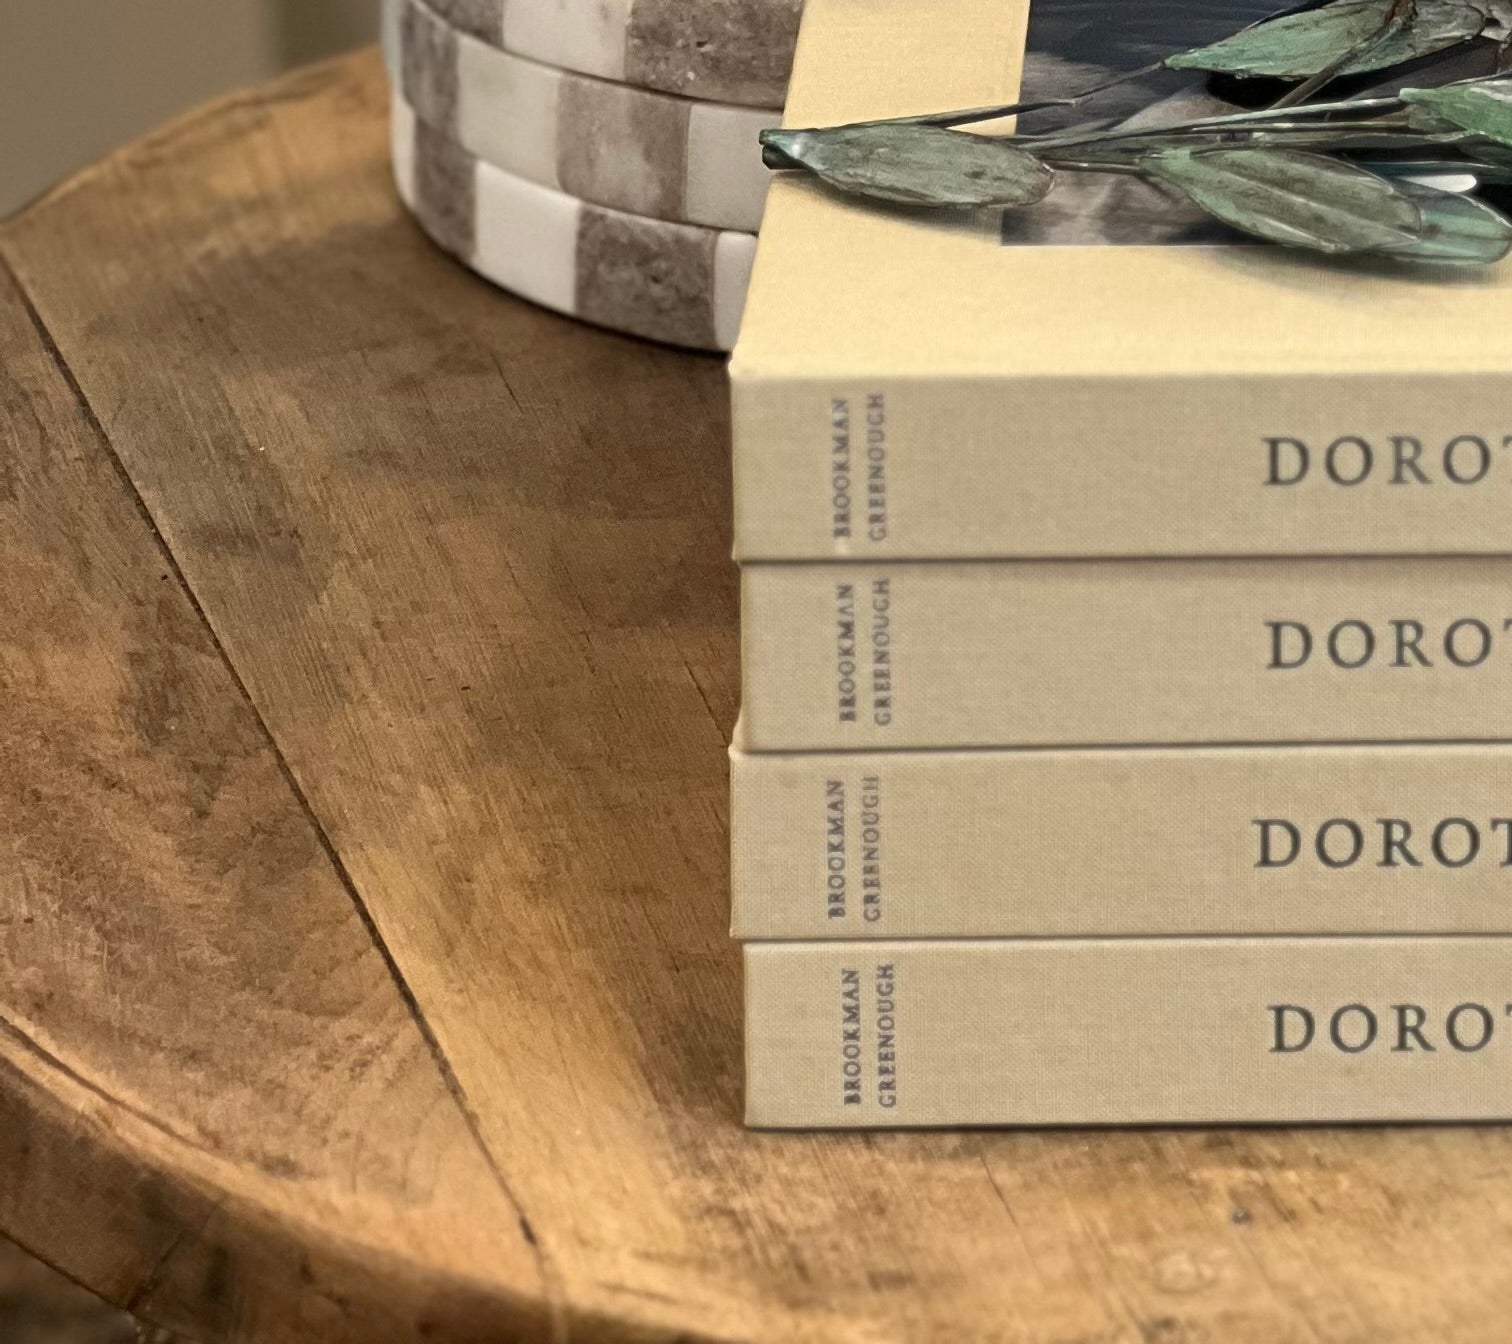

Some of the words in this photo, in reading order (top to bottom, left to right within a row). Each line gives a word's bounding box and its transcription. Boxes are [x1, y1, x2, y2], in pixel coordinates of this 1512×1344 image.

[831, 397, 851, 539] BROOKMAN
[866, 393, 888, 542] GREENOUGH
[838, 583, 857, 722] BROOKMAN
[872, 578, 892, 727] GREENOUGH
[826, 778, 846, 919] BROOKMAN
[861, 775, 882, 923] GREENOUGH
[841, 968, 862, 1106] BROOKMAN
[876, 963, 897, 1109] GREENOUGH
